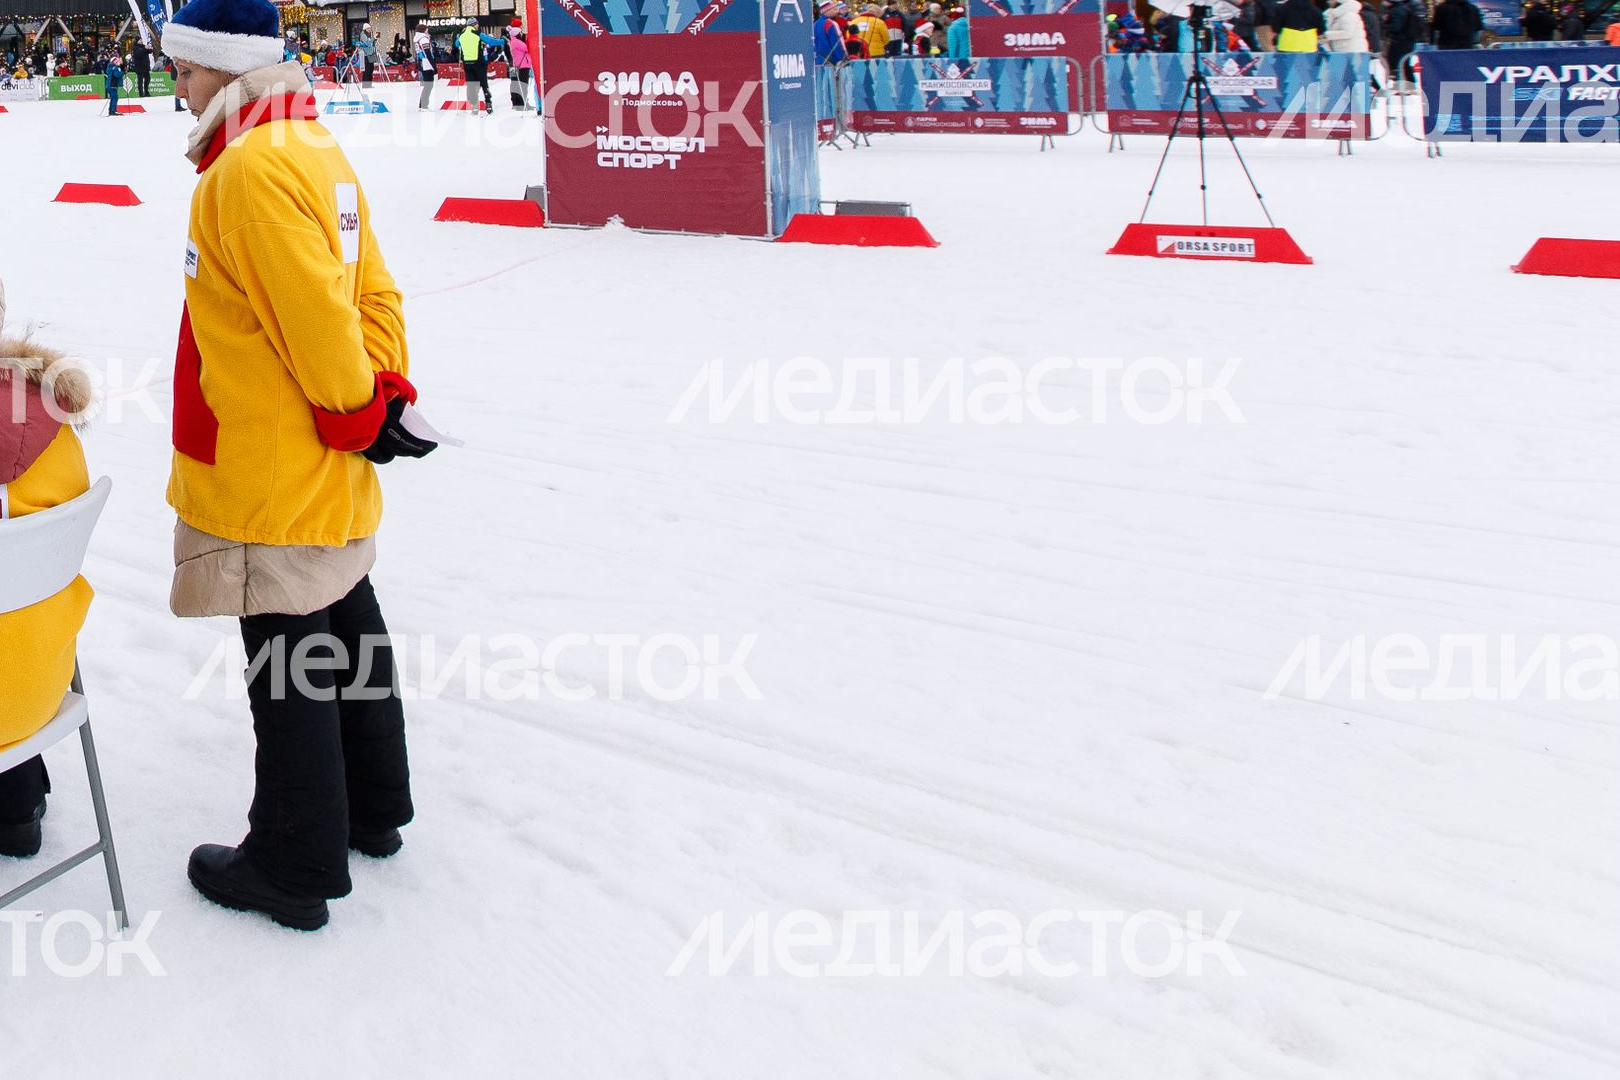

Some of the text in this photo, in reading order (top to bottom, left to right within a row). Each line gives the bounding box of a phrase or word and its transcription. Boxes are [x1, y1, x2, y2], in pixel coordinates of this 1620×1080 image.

[419, 19, 439, 27] MAKE
[1004, 32, 1066, 47] ЗИМА
[772, 53, 806, 79] ЗИМА
[60, 83, 93, 93] ВЫХОД
[597, 71, 699, 96] ЗИМА
[1567, 87, 1620, 101] FACT
[621, 97, 684, 108] Подмосковье
[596, 135, 705, 153] МОСОБЛ
[597, 152, 682, 170] СПОРТ
[1177, 241, 1254, 253] ORSA SPORT
